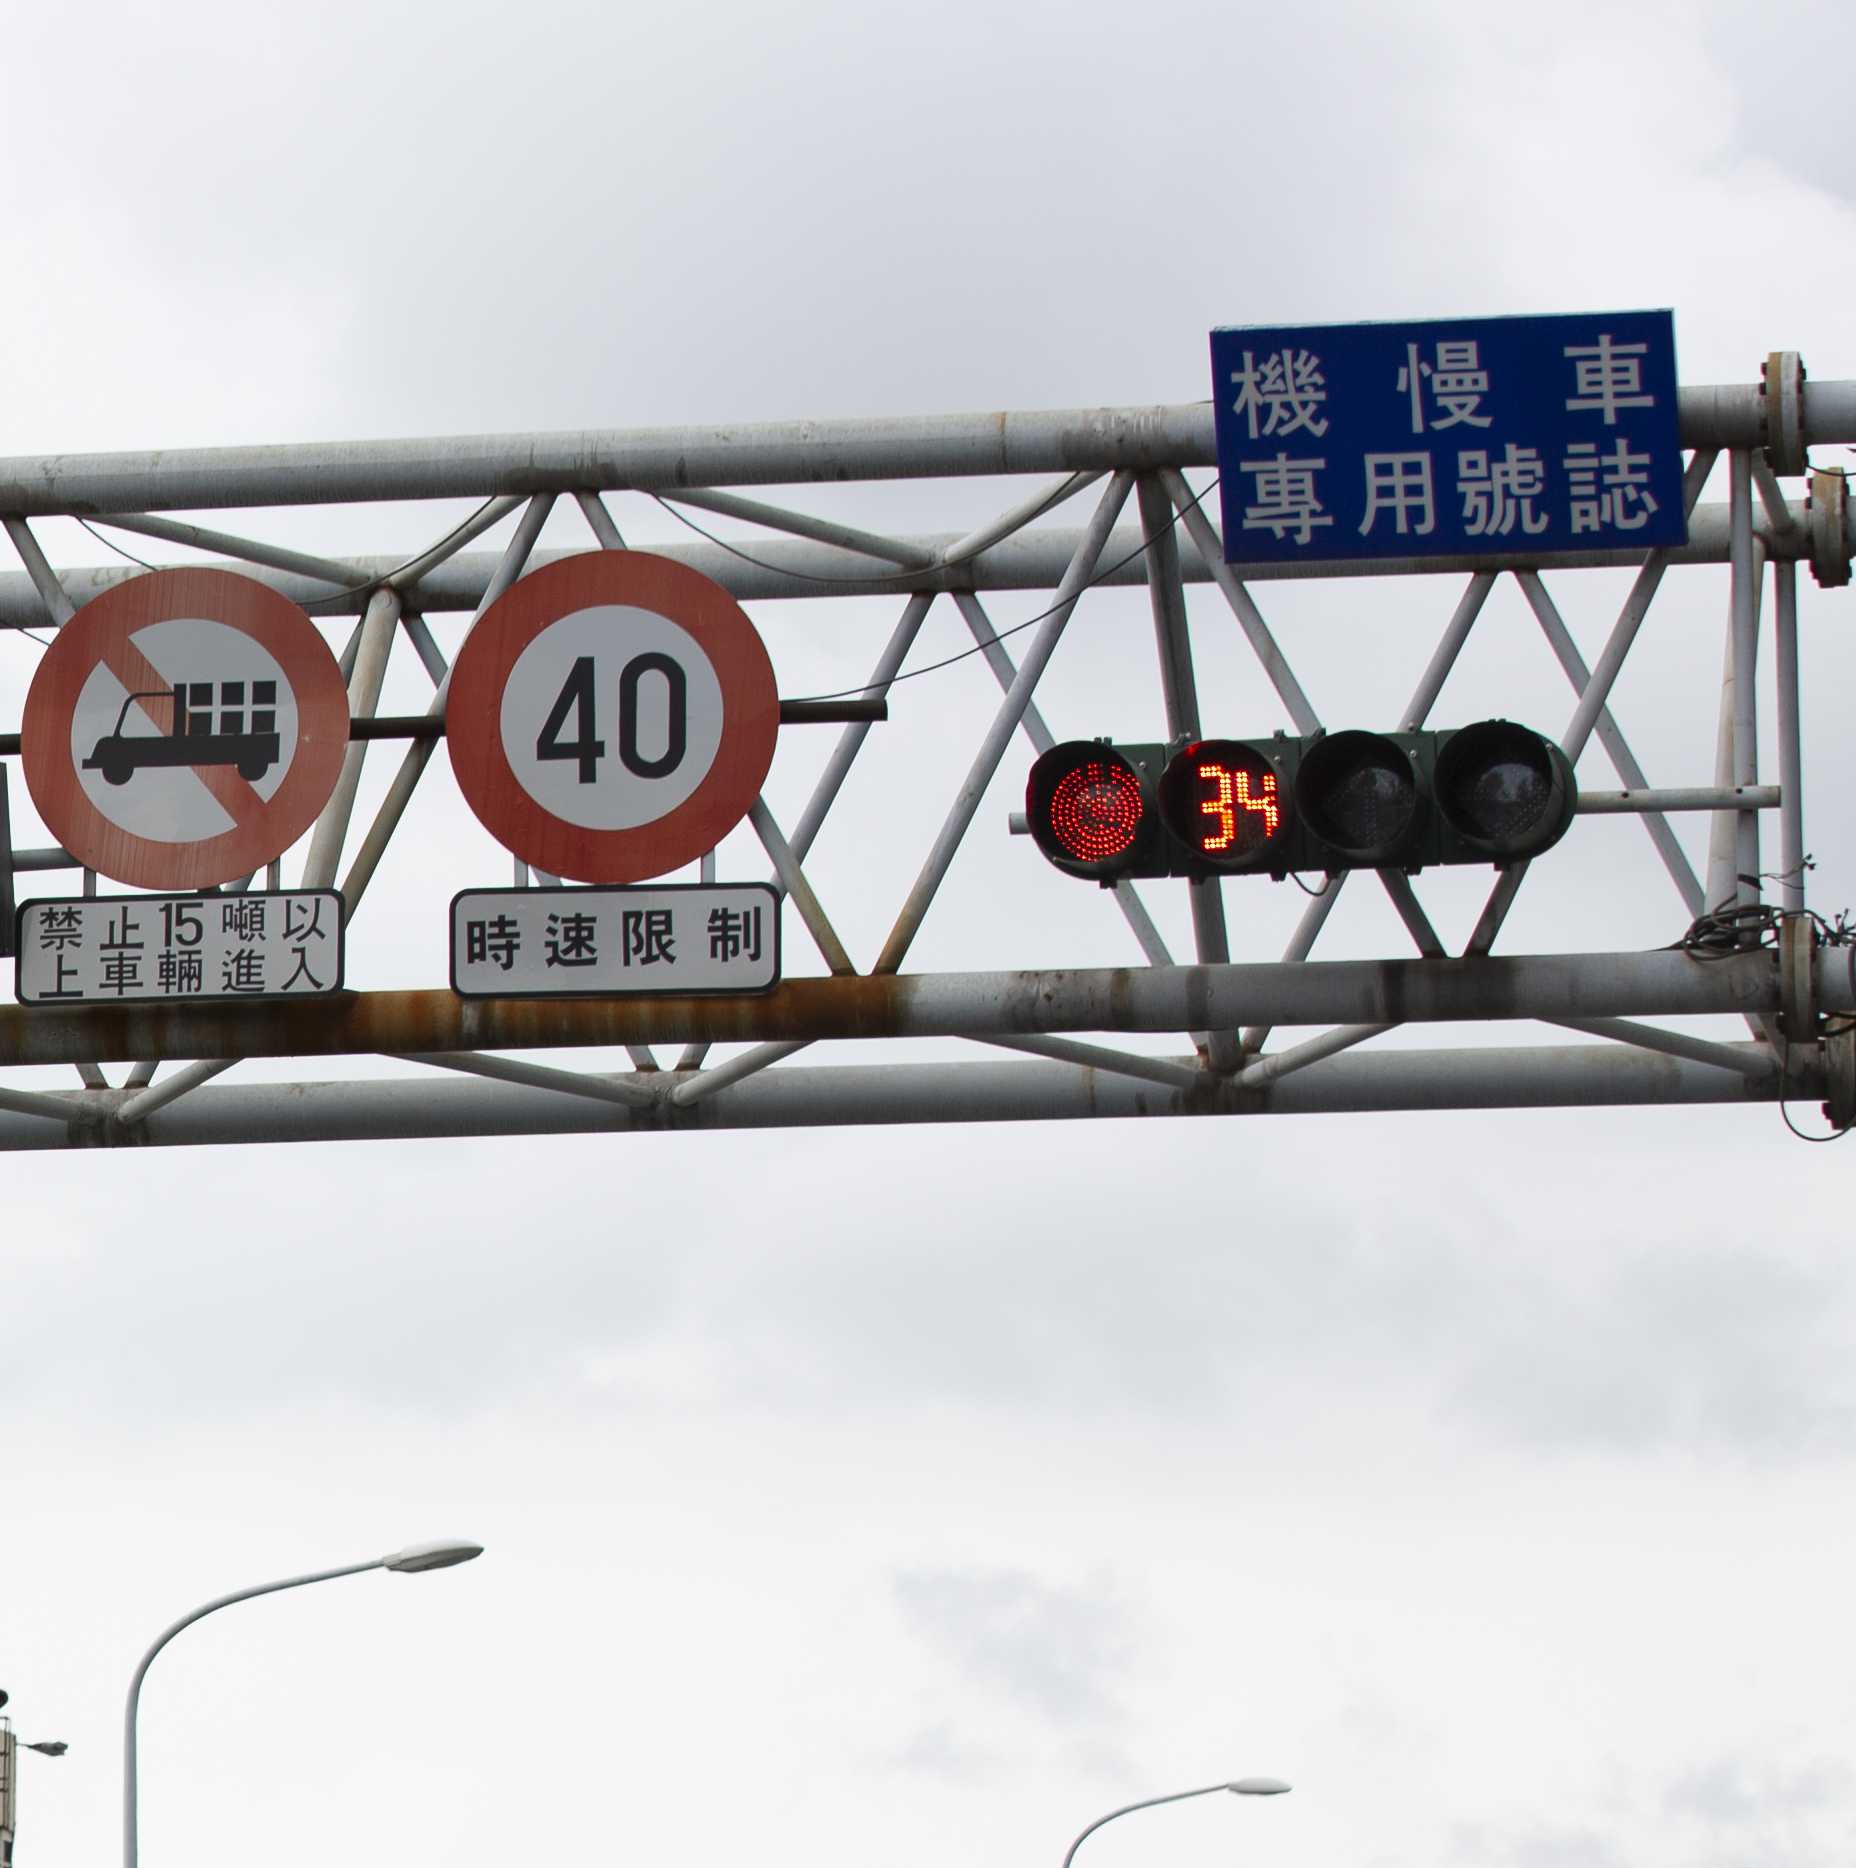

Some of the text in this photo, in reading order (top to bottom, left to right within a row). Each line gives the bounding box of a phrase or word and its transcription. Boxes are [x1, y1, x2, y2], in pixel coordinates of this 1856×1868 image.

[1231, 333, 1654, 442] 機慢車
[1239, 438, 1658, 546] 專用號誌
[536, 651, 687, 784] 40
[1199, 764, 1278, 854] 34
[39, 897, 326, 952] 禁止15噸以
[466, 906, 761, 969] 時速限制
[38, 947, 322, 1000] 上車輛進入
